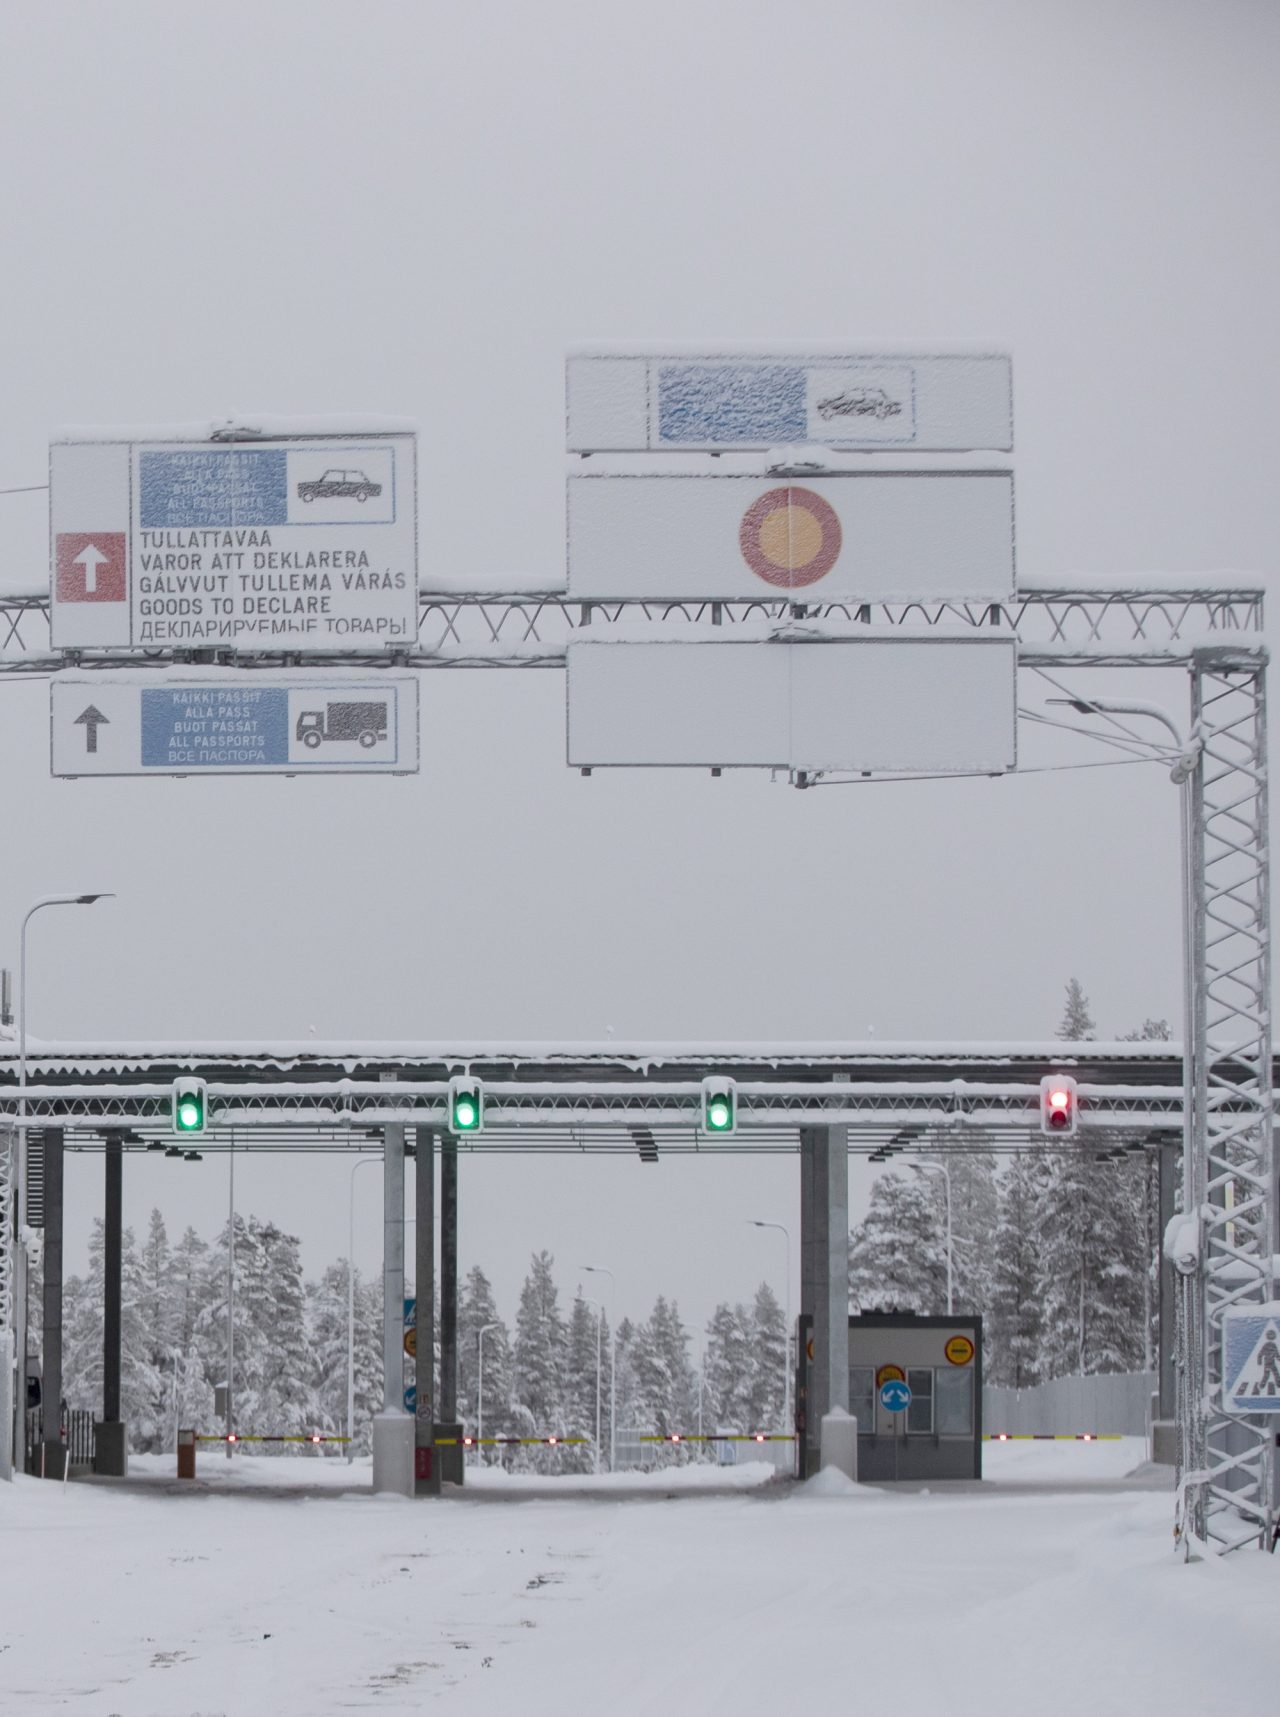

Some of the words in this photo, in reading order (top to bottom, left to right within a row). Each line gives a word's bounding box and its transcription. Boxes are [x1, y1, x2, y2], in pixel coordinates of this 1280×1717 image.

[140, 530, 272, 548] TULLATTAVAA
[140, 553, 202, 571] VAROR
[211, 552, 245, 570] ATT
[253, 550, 370, 569] DEKLARERA
[140, 570, 229, 593] GÁLVVUT
[239, 574, 332, 592] TULLEMA
[341, 568, 407, 591] VÁRÁS
[140, 598, 203, 616] GOODS
[211, 597, 234, 615] TO
[243, 596, 331, 614] DECLARE
[172, 693, 214, 704] KAIKKI
[218, 692, 261, 703] PASSIT
[185, 706, 213, 718] ALLA
[218, 706, 251, 718] PASS
[174, 722, 207, 733] BUOT
[212, 721, 258, 732] PASSAT
[168, 736, 189, 748] ALL
[194, 735, 265, 747] PASSPORTS
